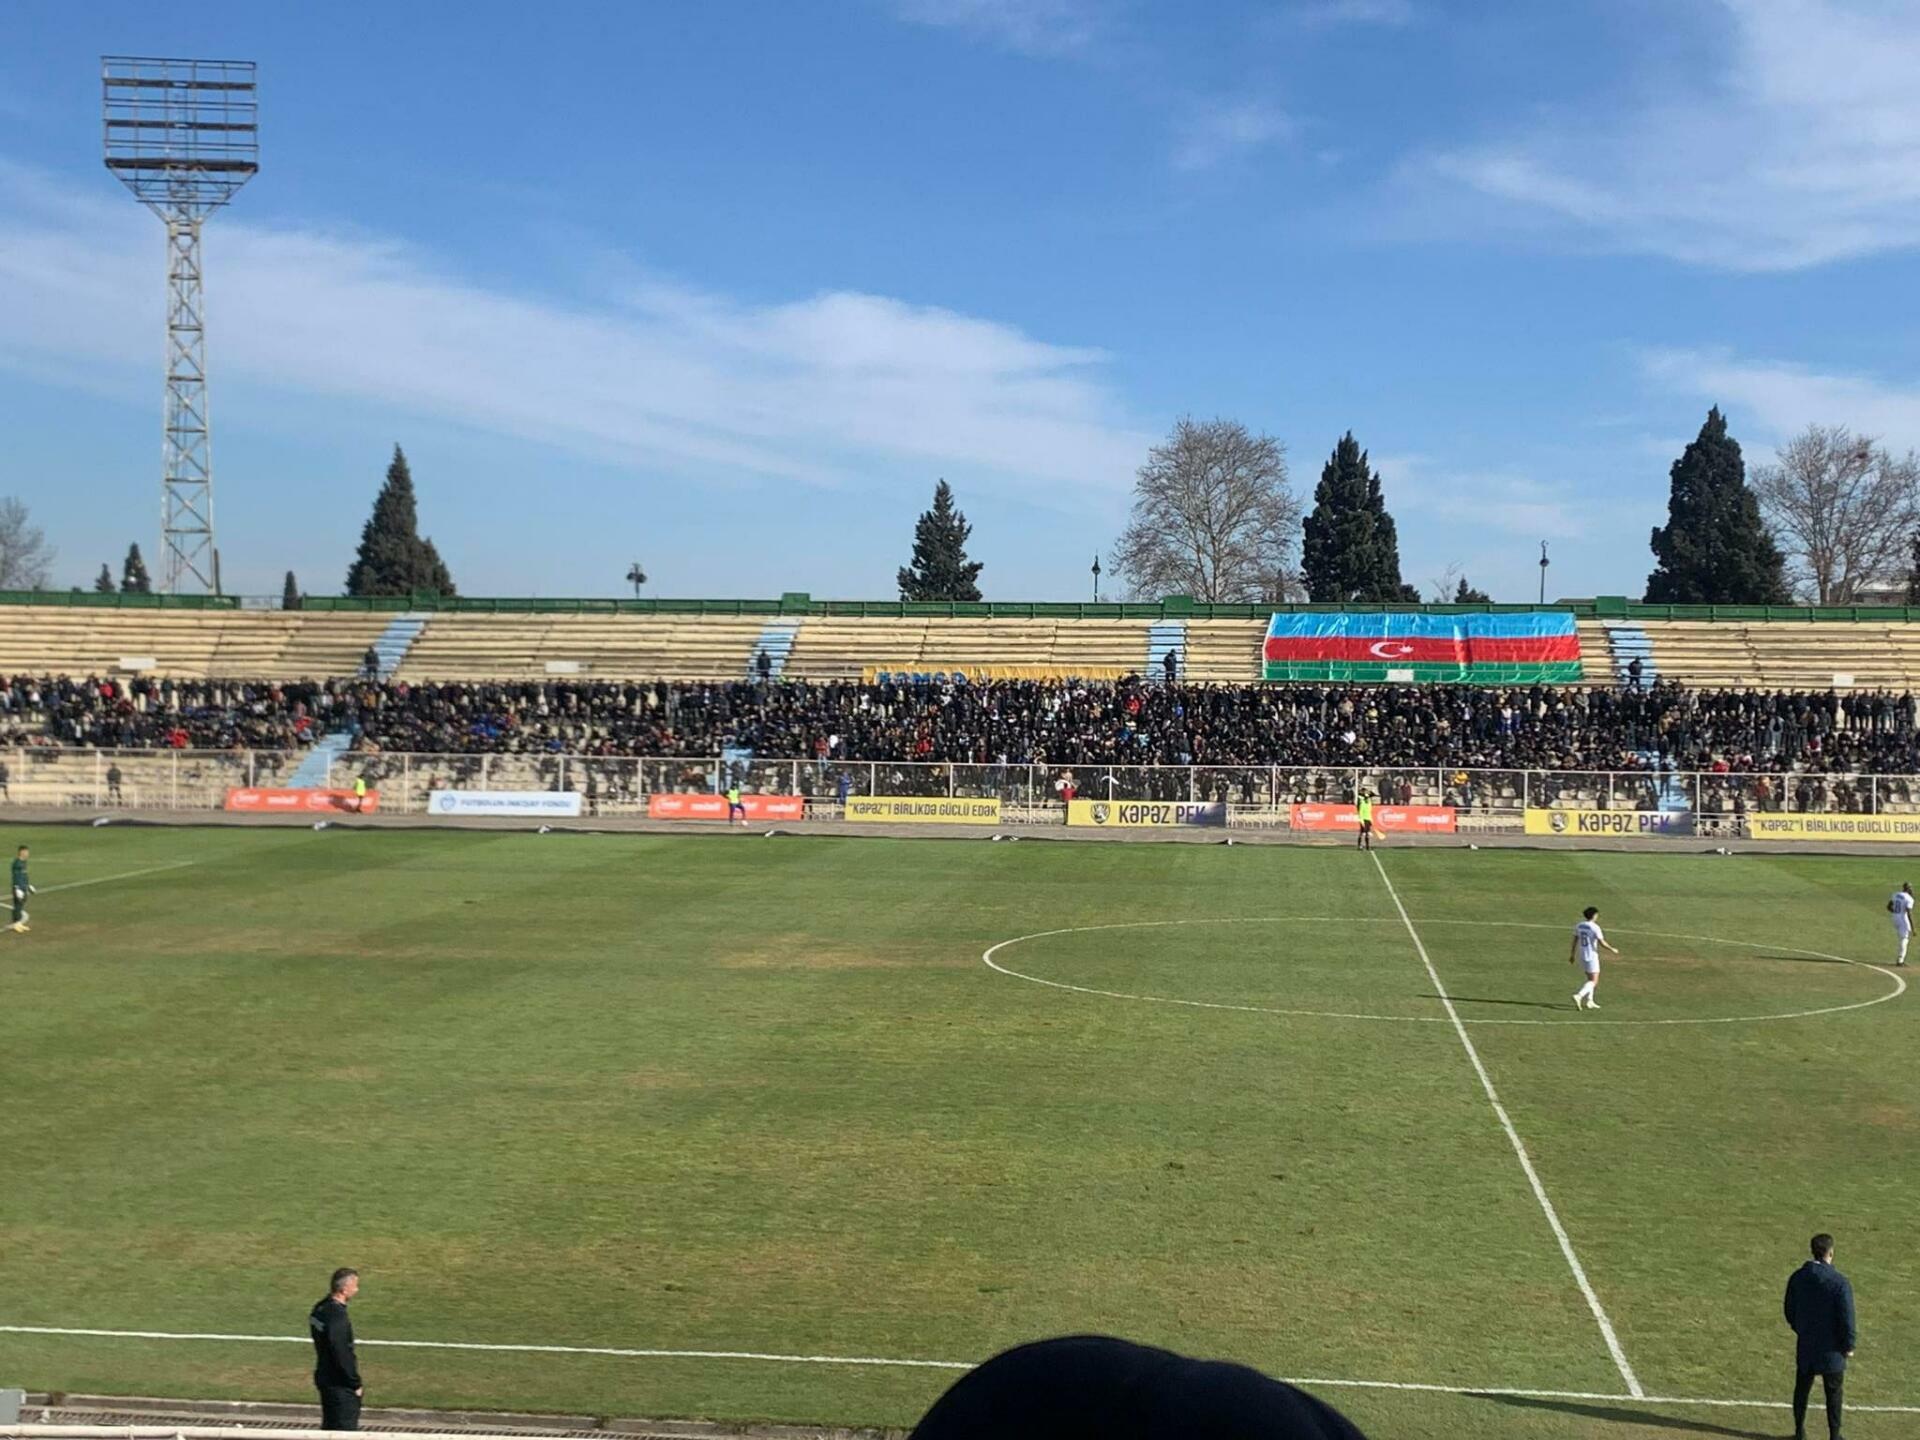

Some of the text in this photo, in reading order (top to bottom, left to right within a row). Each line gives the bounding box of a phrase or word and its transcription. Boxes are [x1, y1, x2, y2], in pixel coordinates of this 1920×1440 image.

[972, 805, 998, 817] EDƏK
[1119, 804, 1171, 824] KƏPƏZ
[1578, 813, 1634, 832] KƏPƏZ
